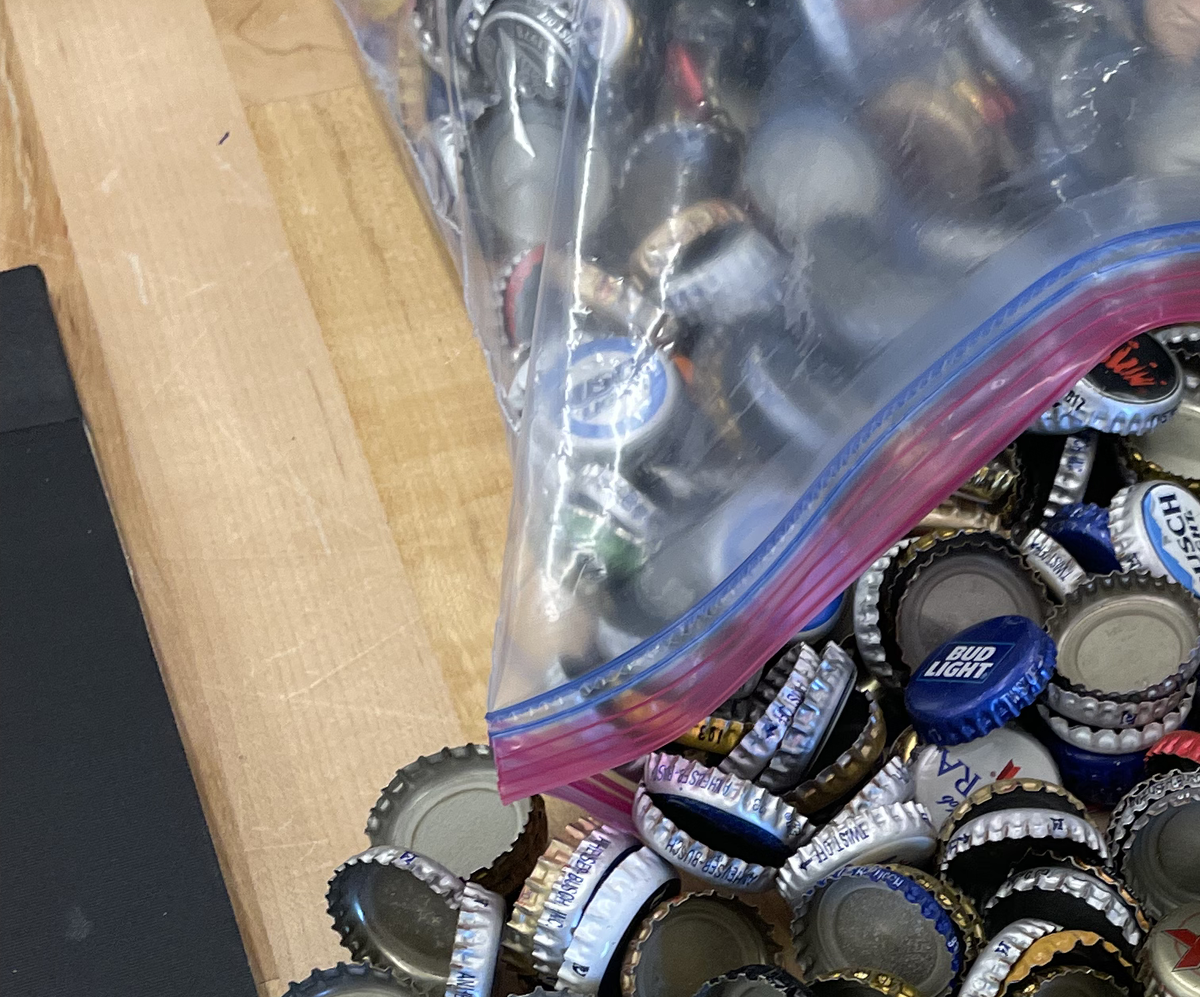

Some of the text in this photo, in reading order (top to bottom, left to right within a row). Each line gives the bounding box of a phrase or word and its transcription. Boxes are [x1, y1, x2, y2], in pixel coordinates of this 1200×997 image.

[944, 645, 997, 662] BUD
[923, 660, 994, 680] LIGHT
[835, 821, 870, 852] TWIST
